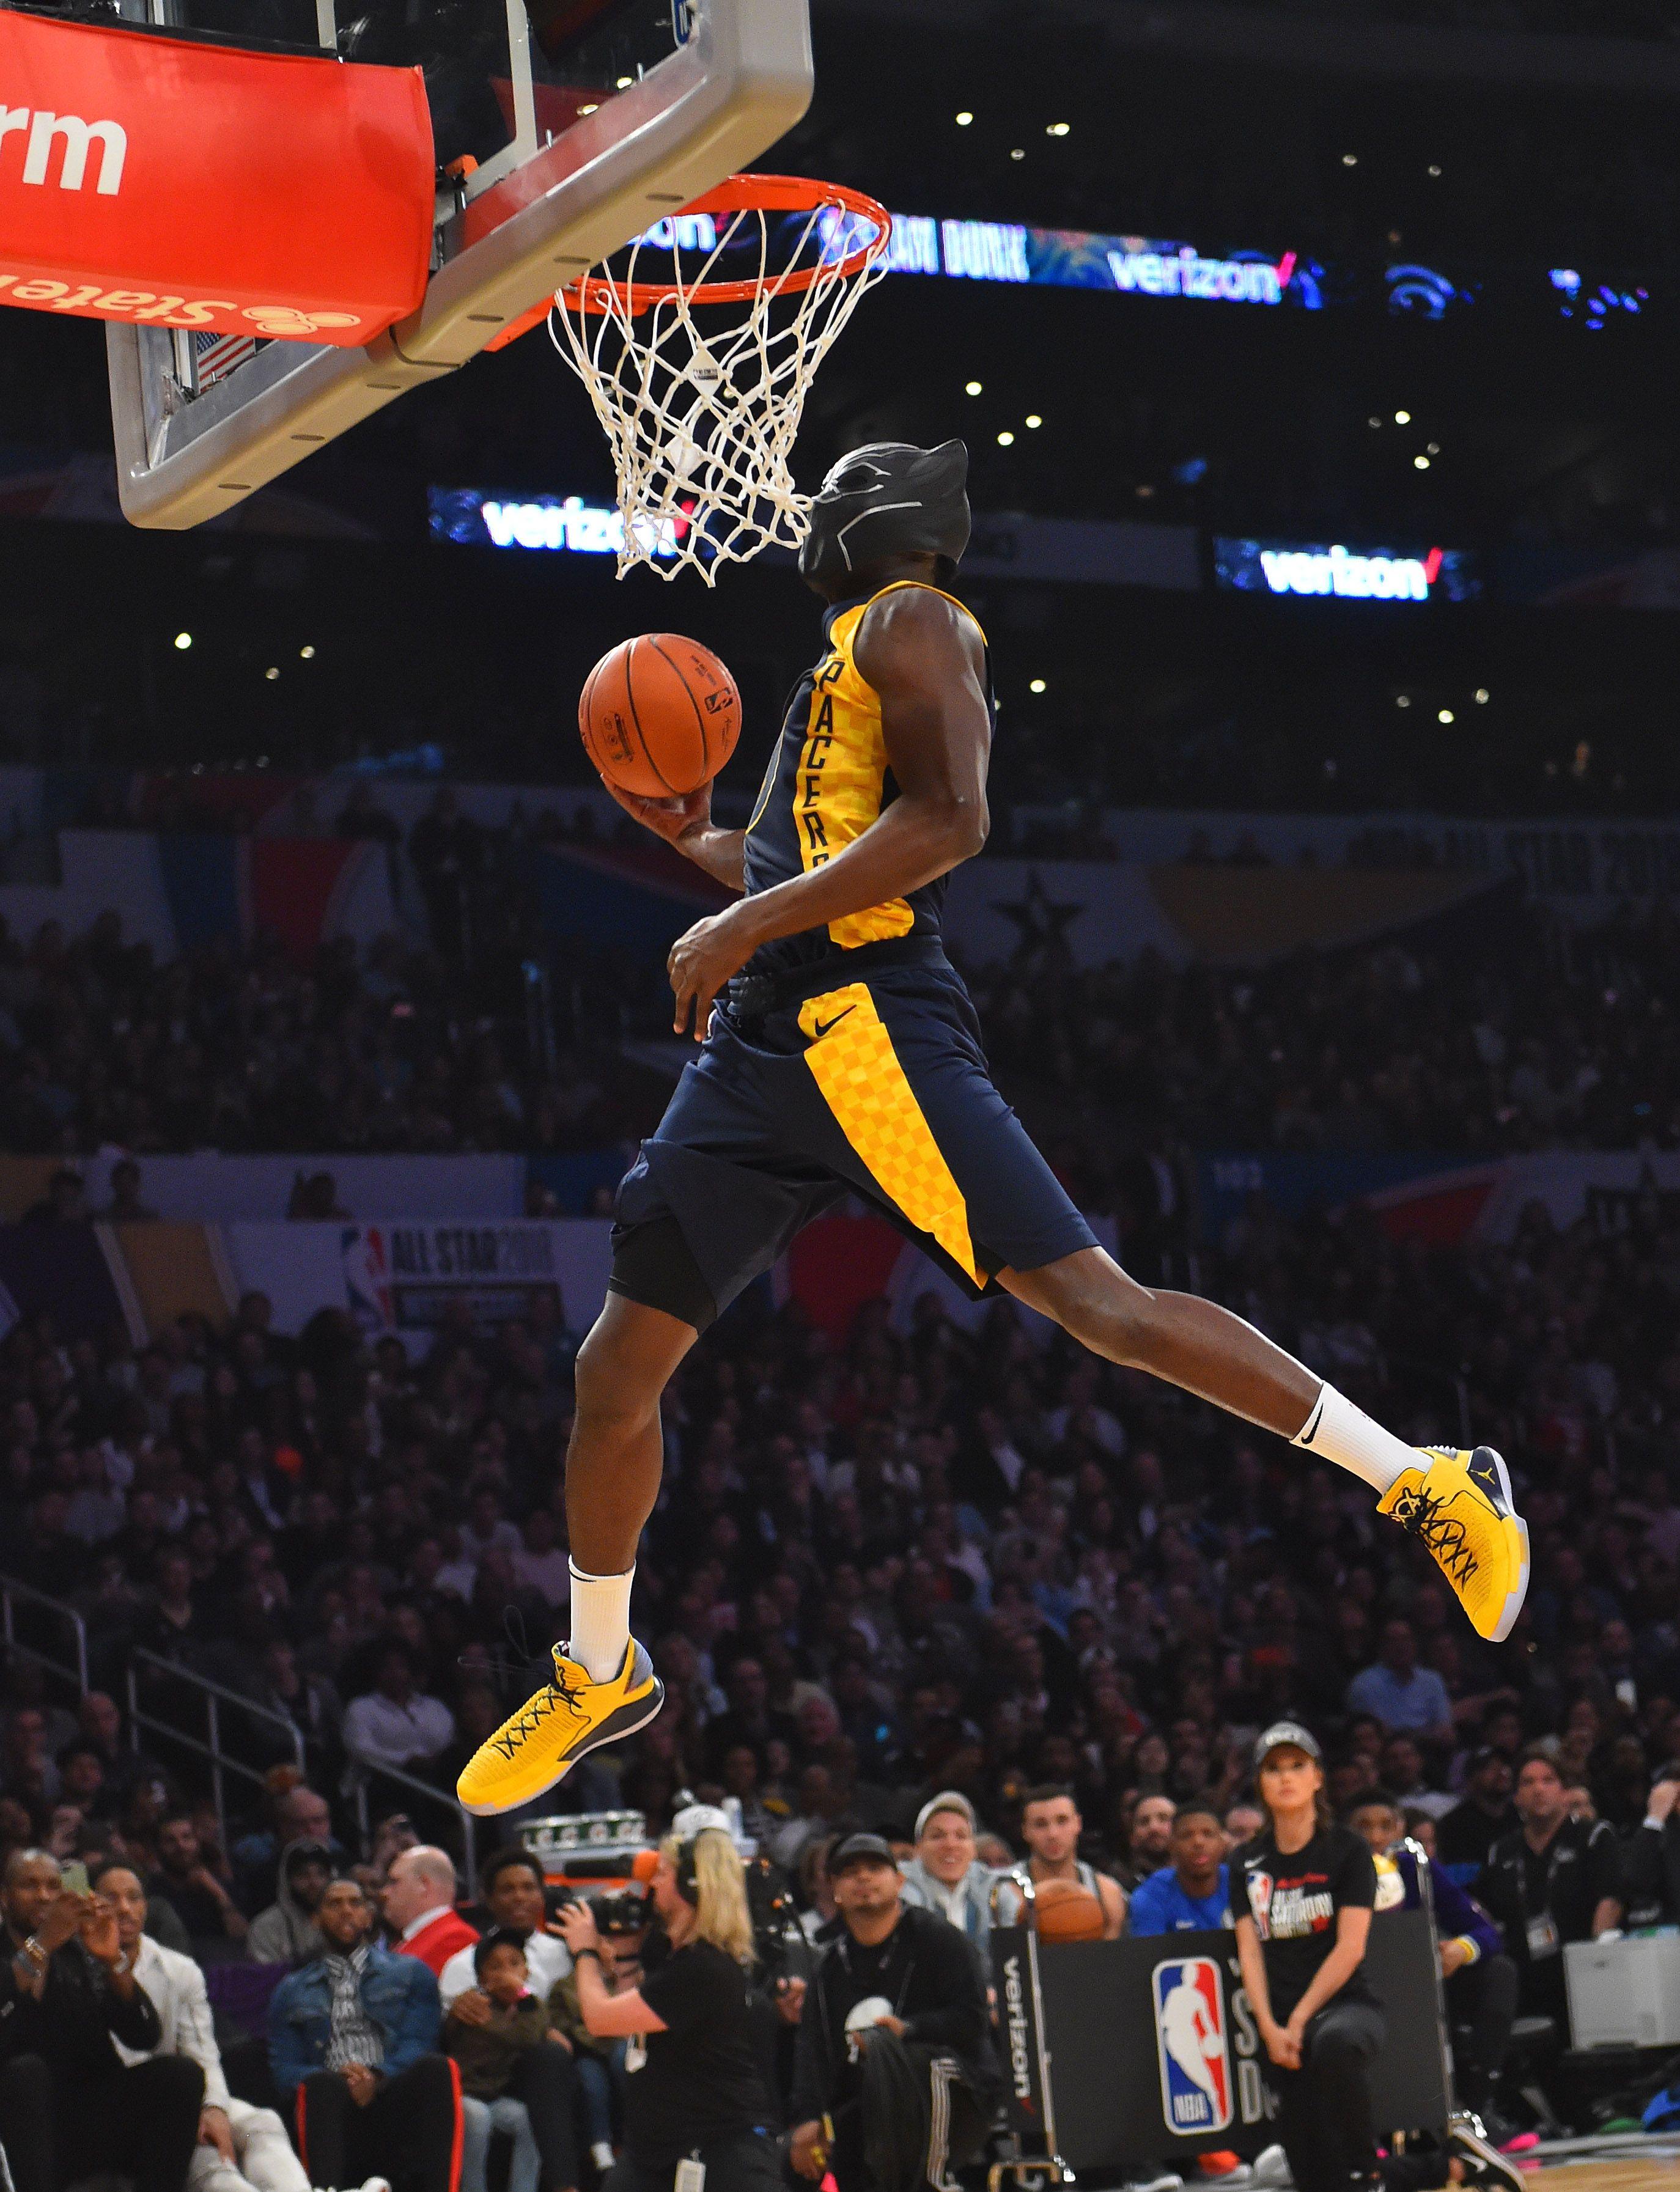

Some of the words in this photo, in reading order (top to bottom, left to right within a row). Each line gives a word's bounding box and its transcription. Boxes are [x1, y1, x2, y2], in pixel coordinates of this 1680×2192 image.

[1107, 247, 1282, 305] verizon
[482, 496, 677, 557] verizon
[1261, 545, 1428, 600] verizon
[392, 1229, 430, 1274] ALL
[435, 1227, 497, 1274] STAR
[1003, 1955, 1031, 2098] verizon
[1173, 2092, 1210, 2123] NBA
